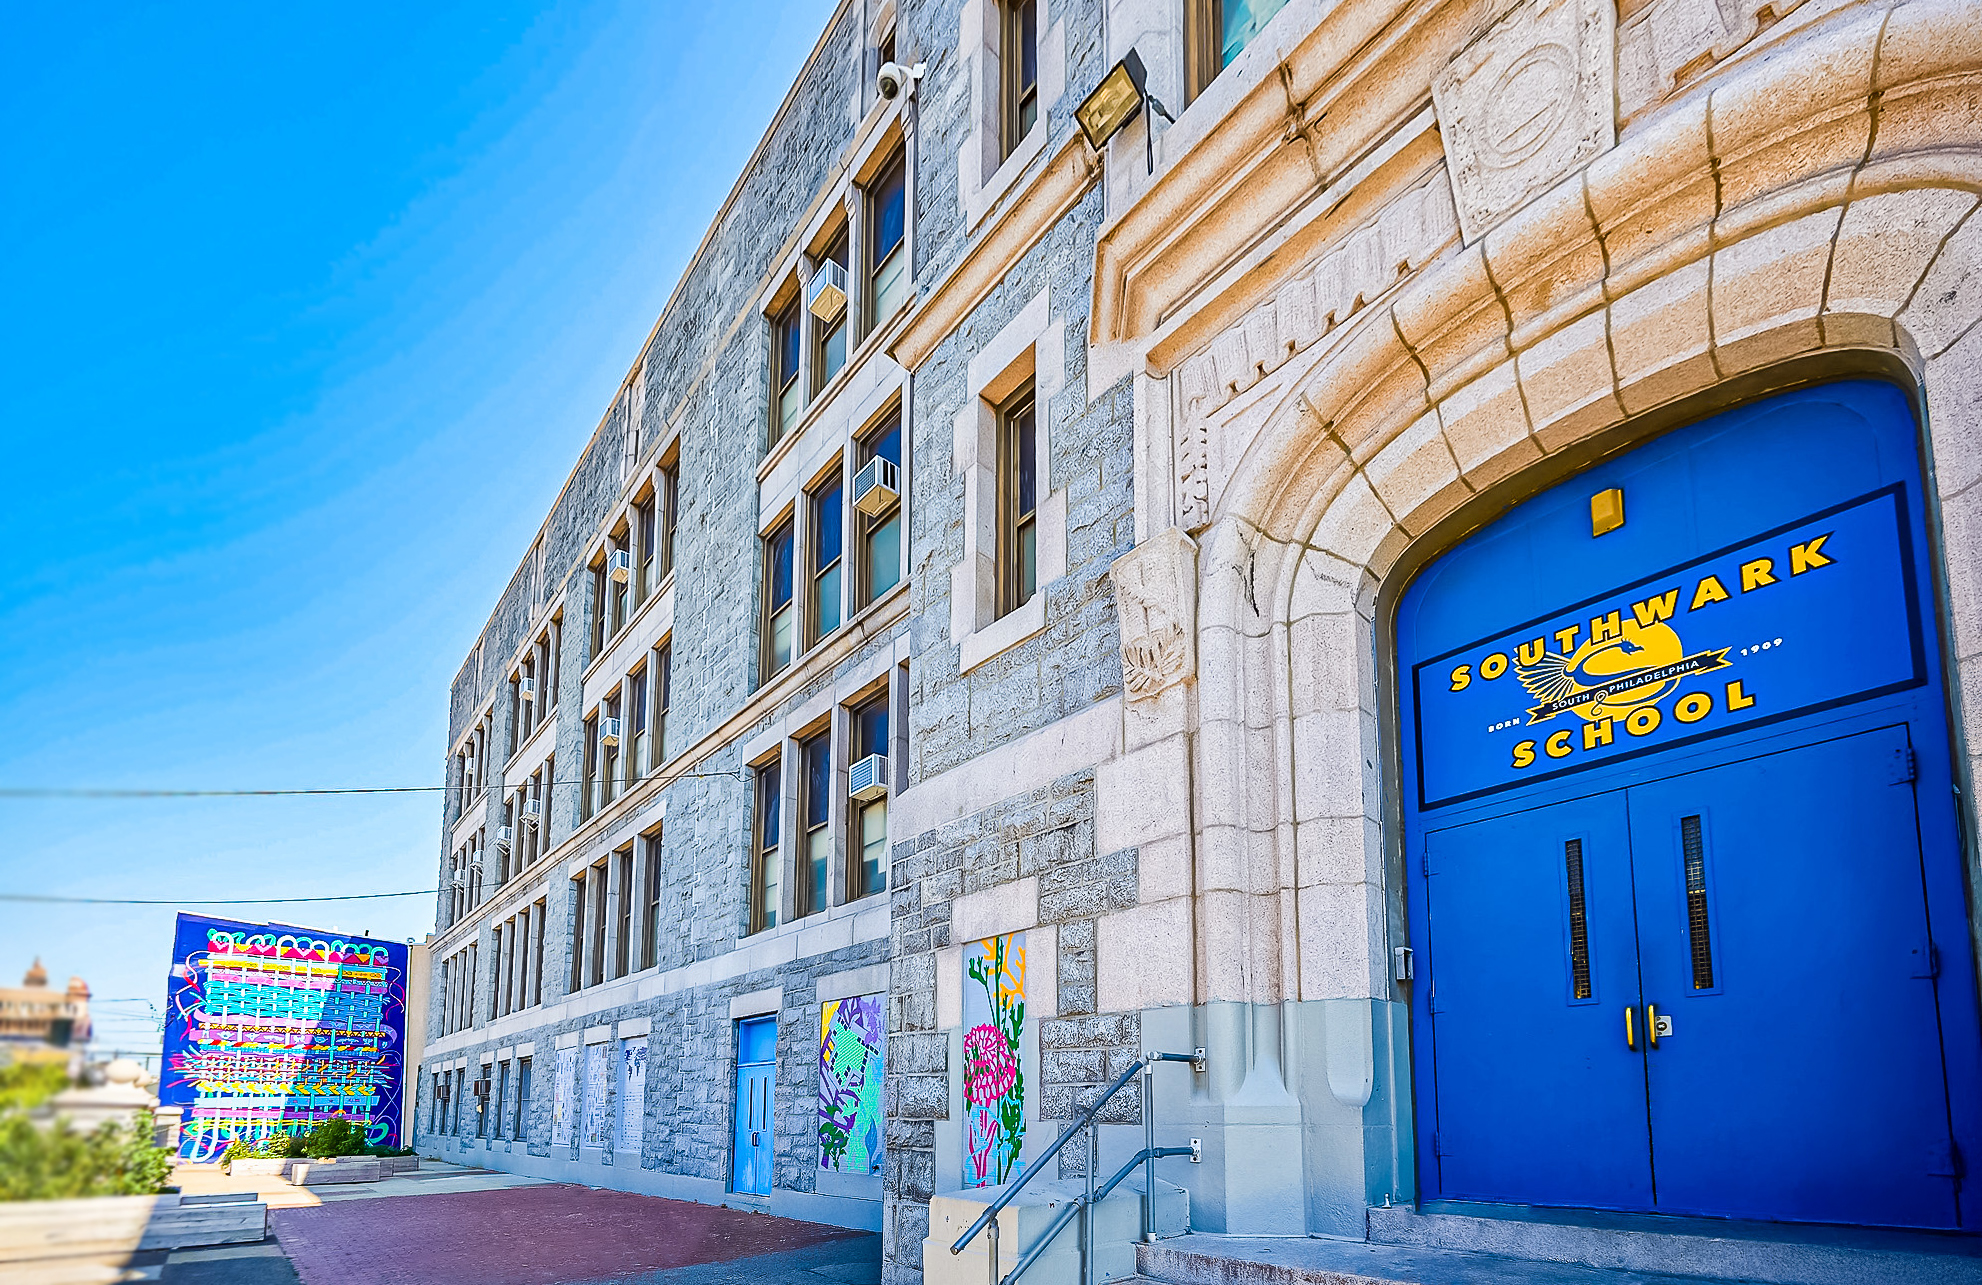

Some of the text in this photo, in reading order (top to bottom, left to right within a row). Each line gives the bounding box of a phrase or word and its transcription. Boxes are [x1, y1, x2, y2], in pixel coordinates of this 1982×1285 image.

[1449, 531, 1838, 693] SOUTHWARK
[1488, 637, 1783, 733] BORN 1909
[1511, 679, 1757, 769] SCHOOL
[1552, 660, 1700, 711] SOUTH PHILADELPHIA
